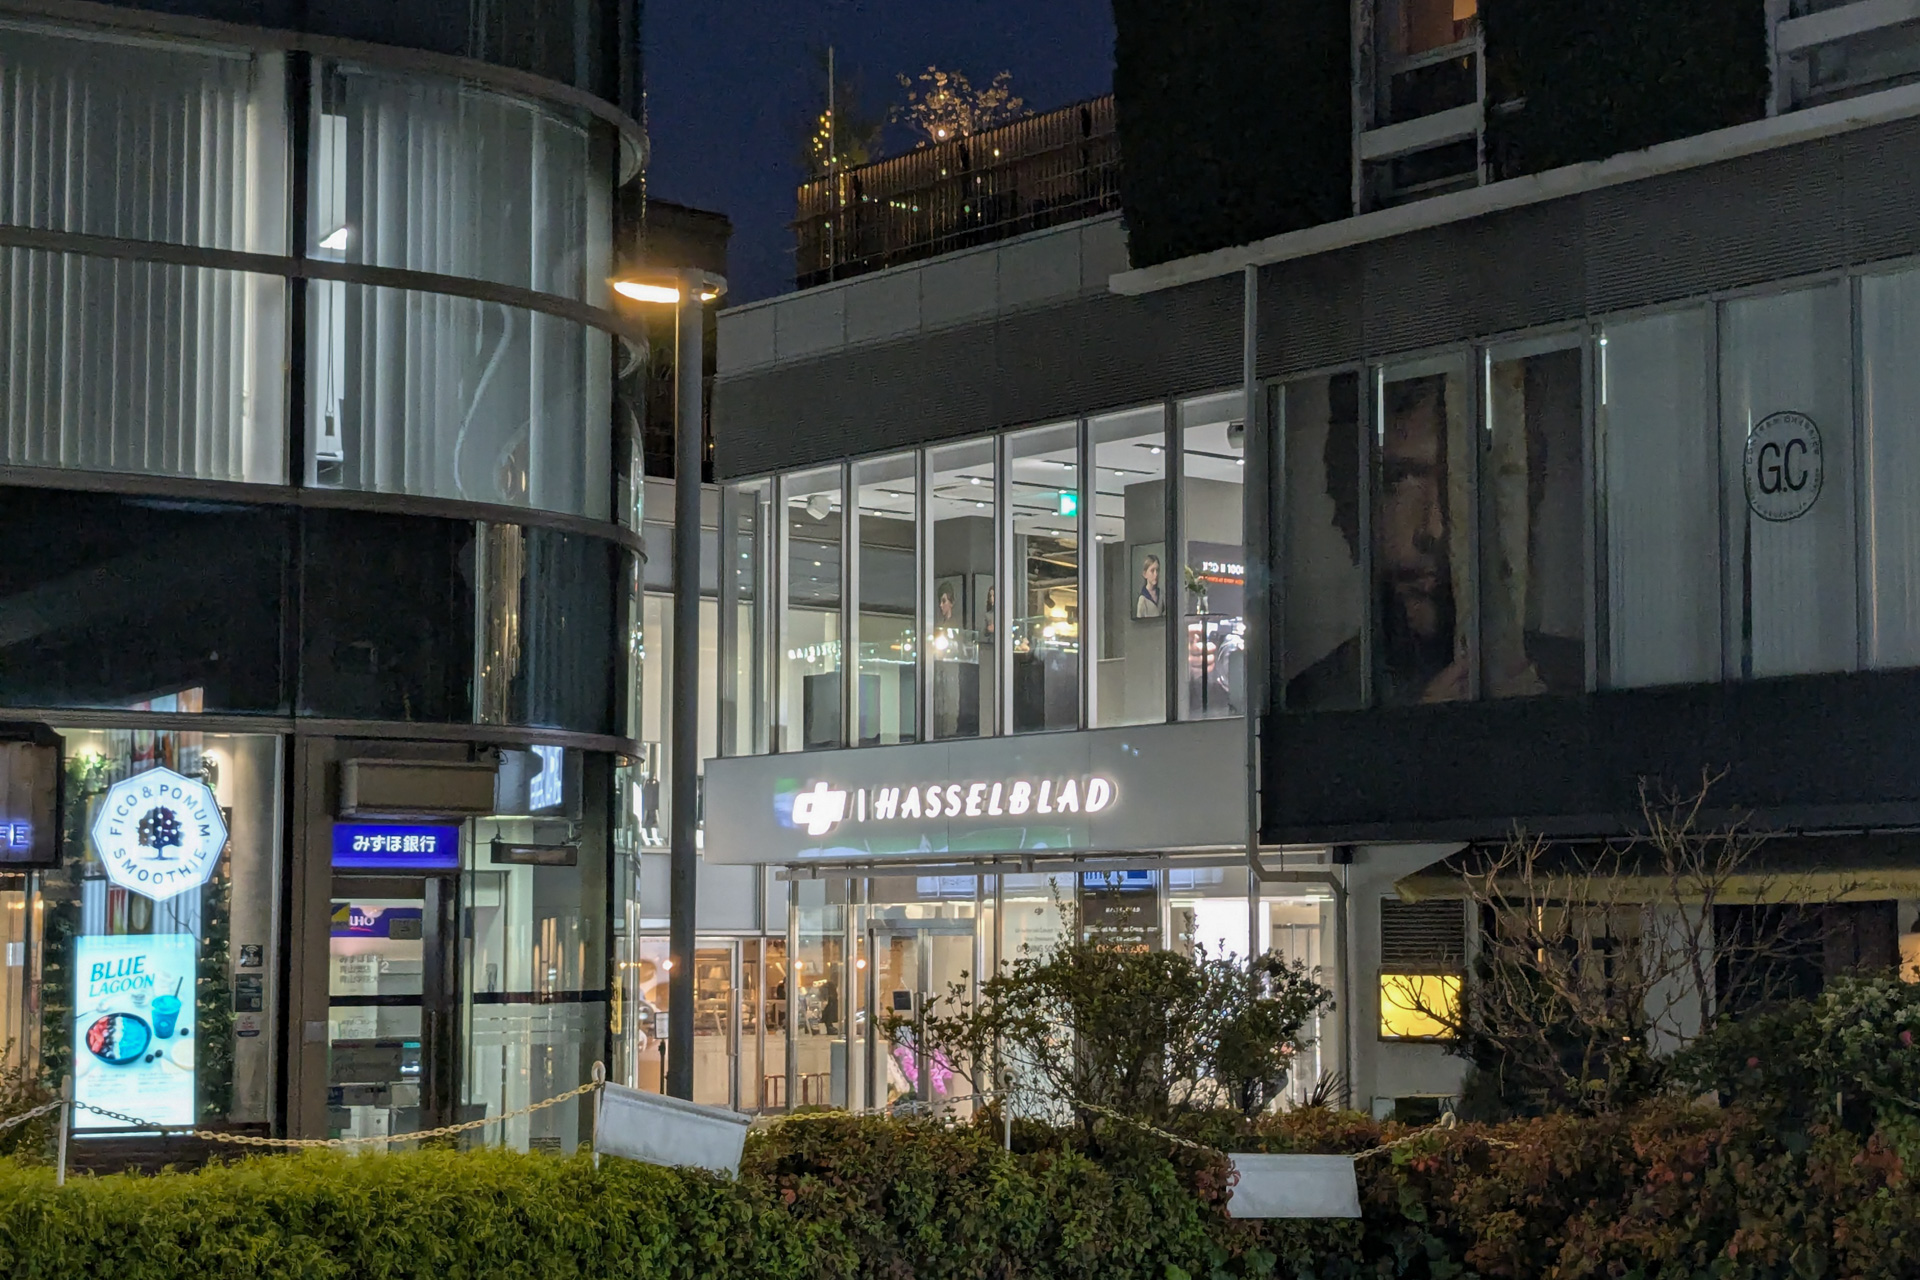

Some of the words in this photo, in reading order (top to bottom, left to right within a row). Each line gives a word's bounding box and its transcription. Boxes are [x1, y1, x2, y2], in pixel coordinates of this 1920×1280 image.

[110, 794, 138, 836] FICO
[142, 786, 153, 798] &
[160, 784, 211, 837] POMUM
[874, 778, 1110, 820] HASSELBLAD
[353, 835, 436, 852] みずほ銀行
[113, 847, 207, 884] SMOOTHIE
[90, 955, 147, 982] BLUE
[89, 973, 155, 998] LAGOON
